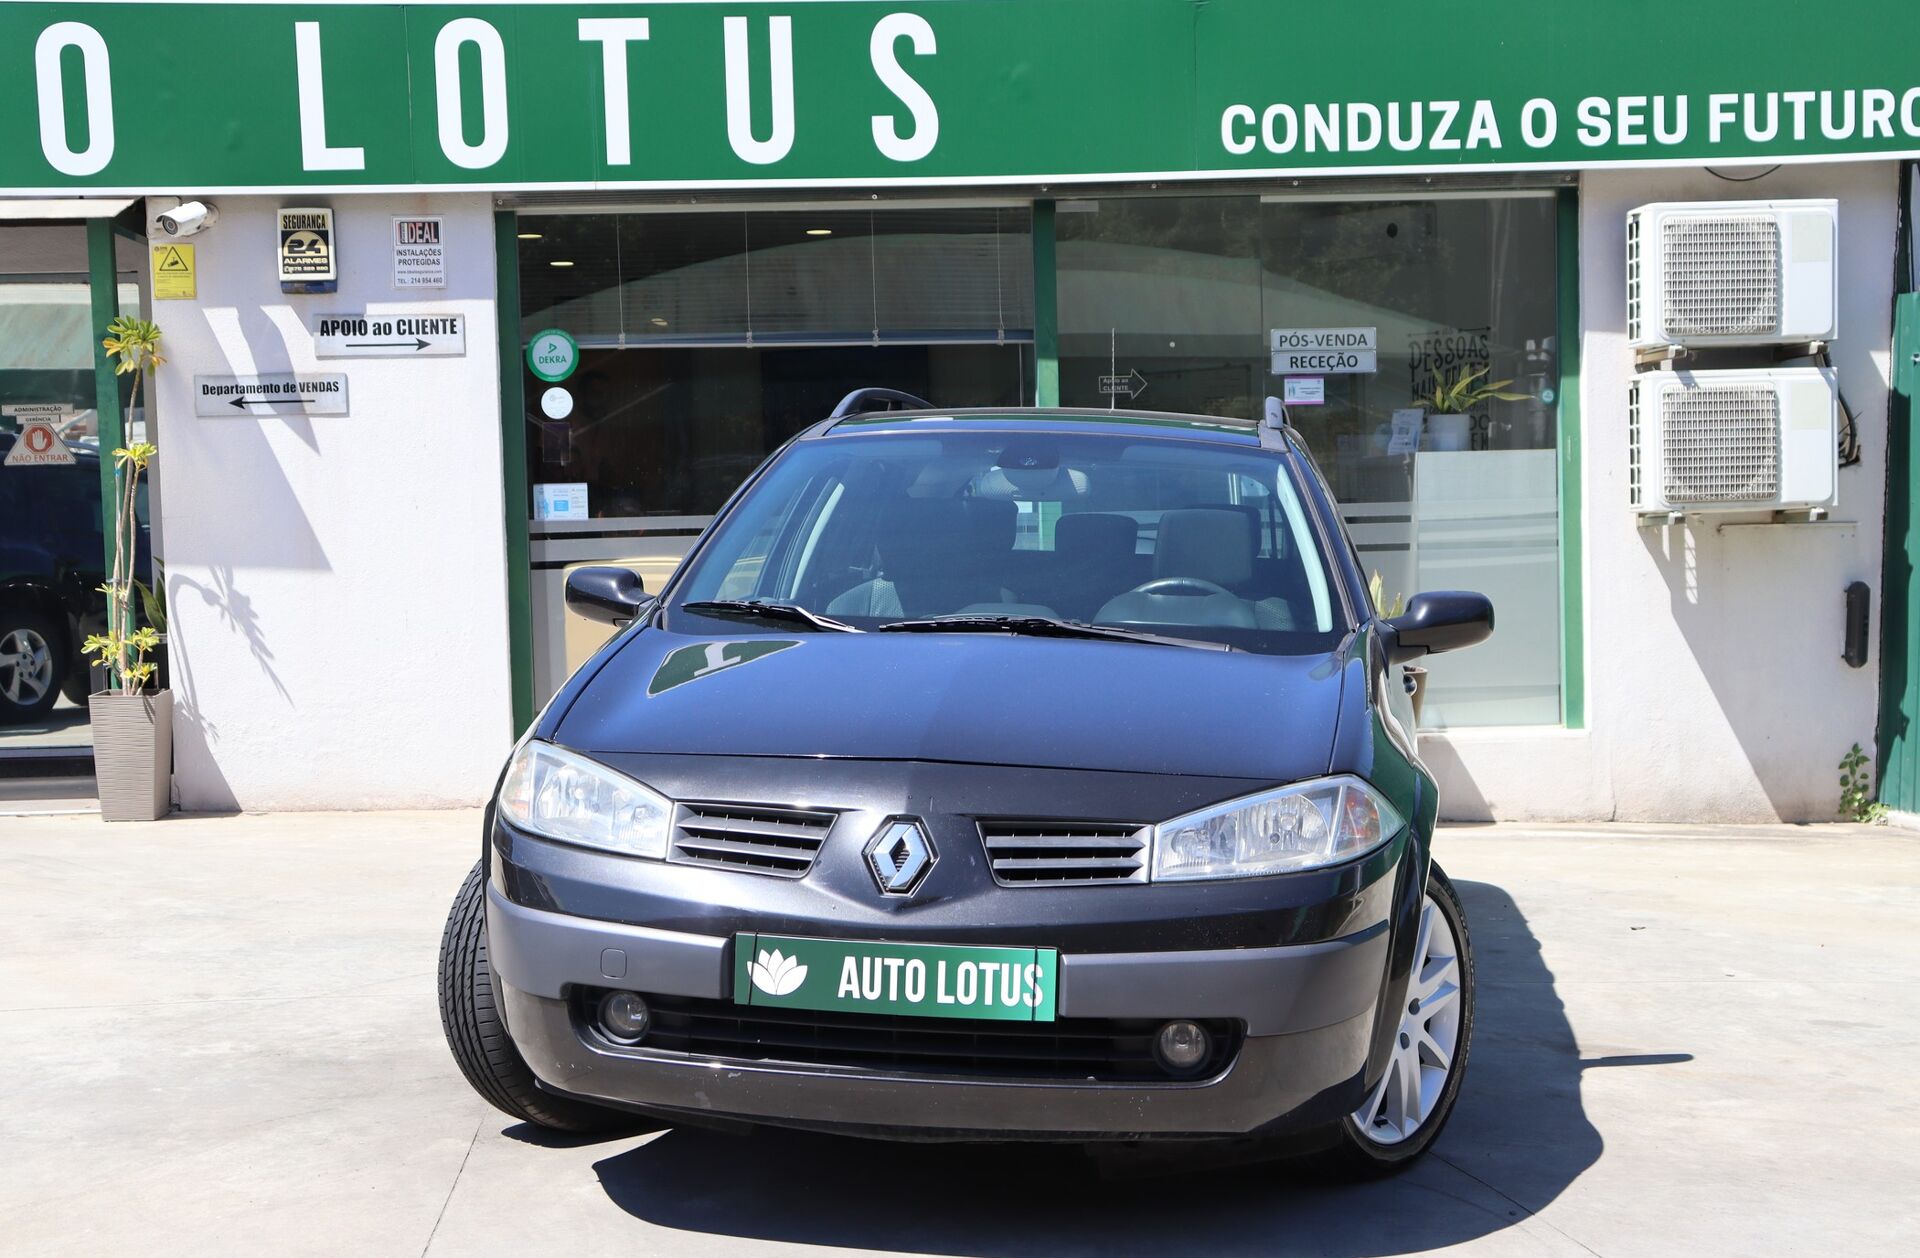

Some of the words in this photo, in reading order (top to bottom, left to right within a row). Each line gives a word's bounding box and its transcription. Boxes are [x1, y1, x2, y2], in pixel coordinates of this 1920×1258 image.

[35, 21, 116, 177] O
[293, 12, 940, 172] LOTUS
[1221, 98, 1503, 155] CONDUZA
[1520, 97, 1558, 149] O
[1576, 94, 1689, 147] SEU
[1708, 86, 1920, 144] FUTURO
[287, 239, 321, 254] 24
[396, 248, 442, 257] INSTALAÇÕES
[283, 257, 328, 265] ALARMES
[398, 258, 441, 266] PROTEGIDAS
[320, 319, 368, 337] APOIO
[372, 321, 392, 336] ao
[396, 318, 458, 336] CLIENTE
[1279, 331, 1368, 348] PÓS-VENDA
[538, 355, 567, 365] DEKRA
[1290, 352, 1358, 371] RECEÇÃO
[202, 383, 281, 396] Departamento
[283, 382, 297, 393] de
[299, 381, 339, 393] VENDAS
[12, 454, 31, 463] NÃO
[34, 454, 68, 462] ENTRAR
[837, 955, 926, 1003] AUTO
[936, 960, 1043, 1008] LOTUS
